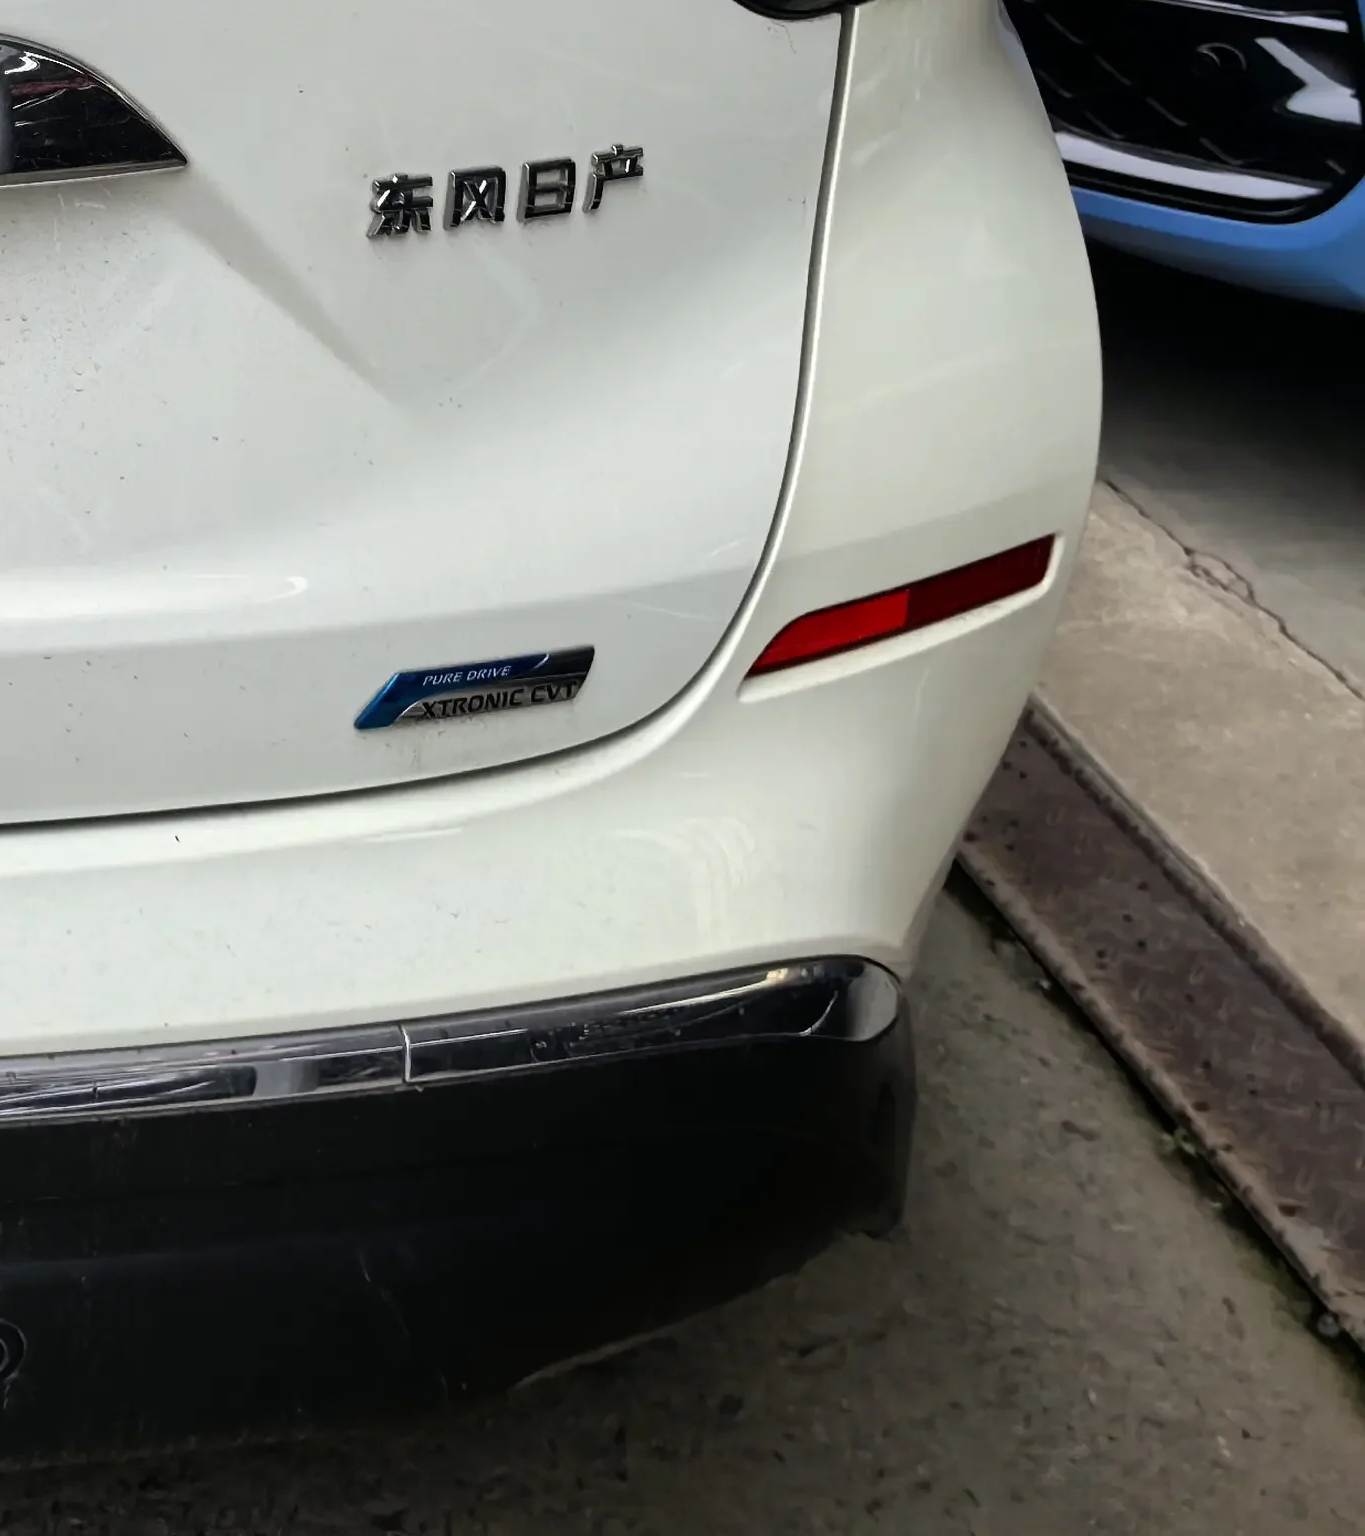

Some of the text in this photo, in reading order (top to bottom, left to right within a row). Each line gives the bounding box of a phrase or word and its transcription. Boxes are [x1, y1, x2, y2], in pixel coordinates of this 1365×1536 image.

[367, 144, 644, 238] 东风日产
[422, 665, 513, 686] PURE DRIVE
[422, 681, 580, 718] XTRONIC CVT
